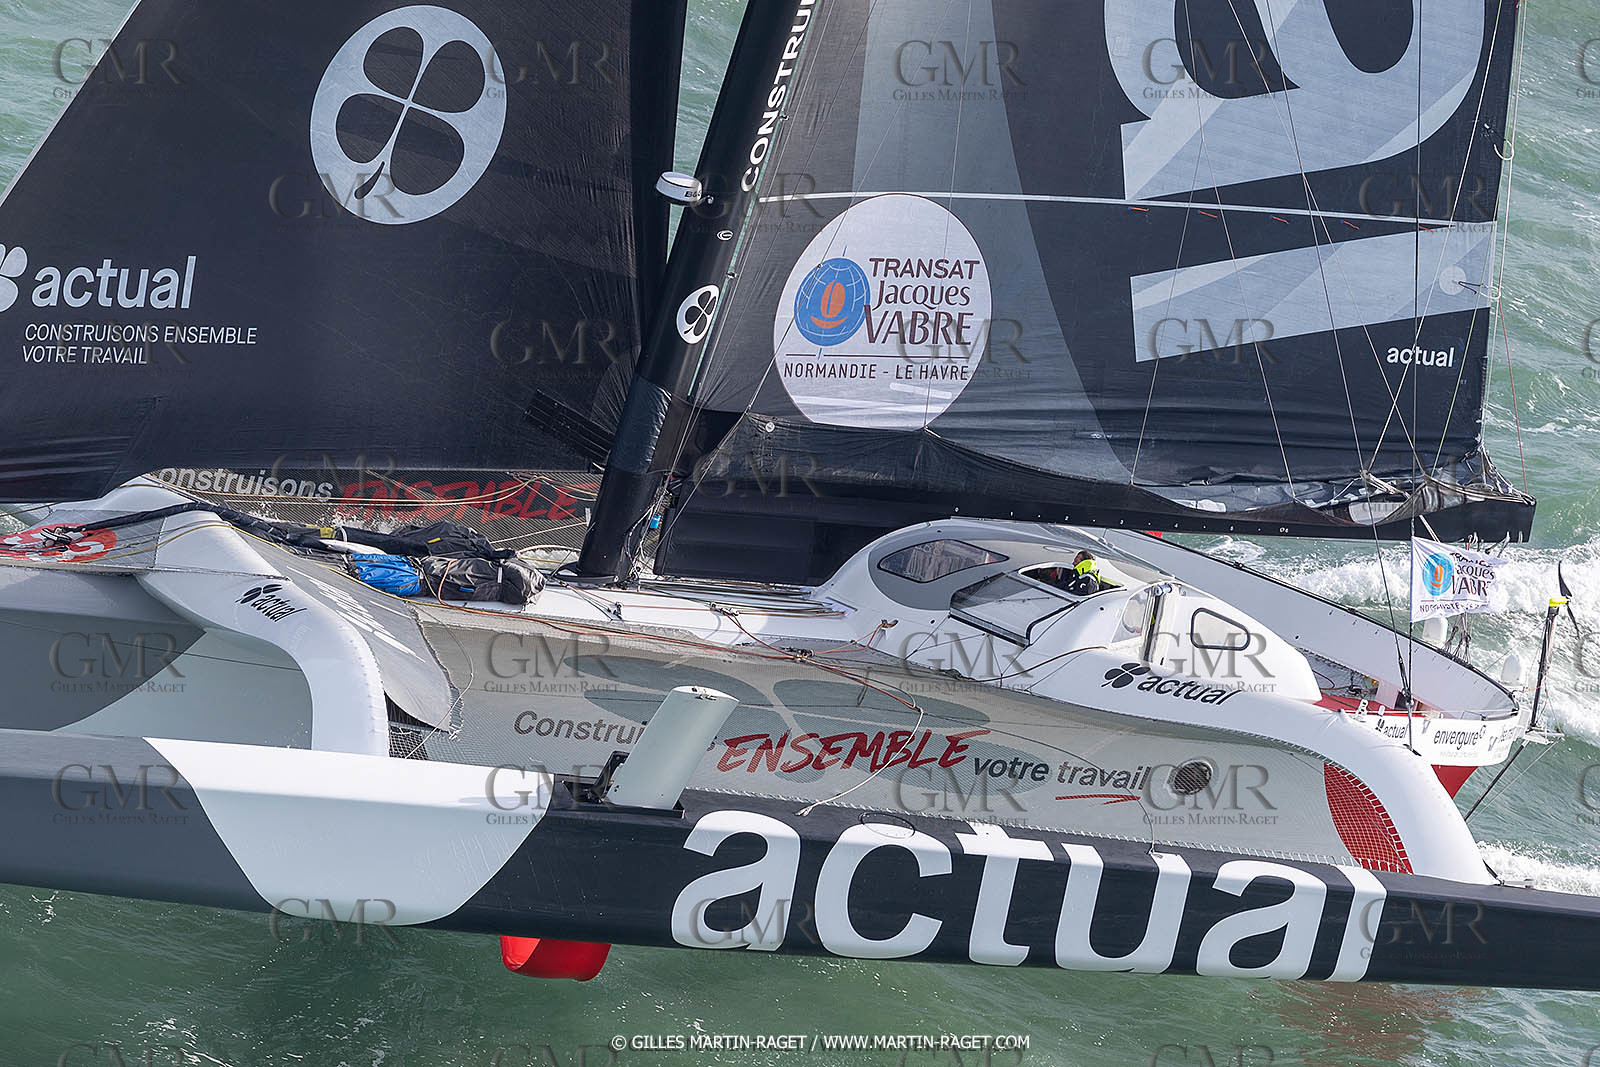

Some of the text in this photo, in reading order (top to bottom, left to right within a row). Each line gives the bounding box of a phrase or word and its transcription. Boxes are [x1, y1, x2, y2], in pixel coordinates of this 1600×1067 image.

[869, 257, 980, 280] TRANSAT
[32, 255, 197, 310] actual
[872, 280, 970, 311] Jacques
[25, 323, 257, 346] CONSTRUISONS ENSEMBLE
[864, 304, 973, 346] VABRE
[22, 345, 149, 365] VOTRE TRAVAIL
[1386, 346, 1455, 367] actual
[784, 362, 877, 379] NORMANDIE
[895, 364, 914, 380] LE
[919, 364, 969, 381] HAVRE
[159, 467, 598, 523] onstruisons ENSEMBLE
[1454, 563, 1496, 580] acques
[251, 595, 307, 622] actual
[1138, 674, 1242, 706] actual
[1383, 724, 1409, 739] actual
[1433, 729, 1479, 750] envergure
[716, 729, 992, 774] ENSEMBLE
[974, 757, 1050, 782] votre
[1057, 761, 1152, 791] travail
[671, 809, 1388, 983] actual
